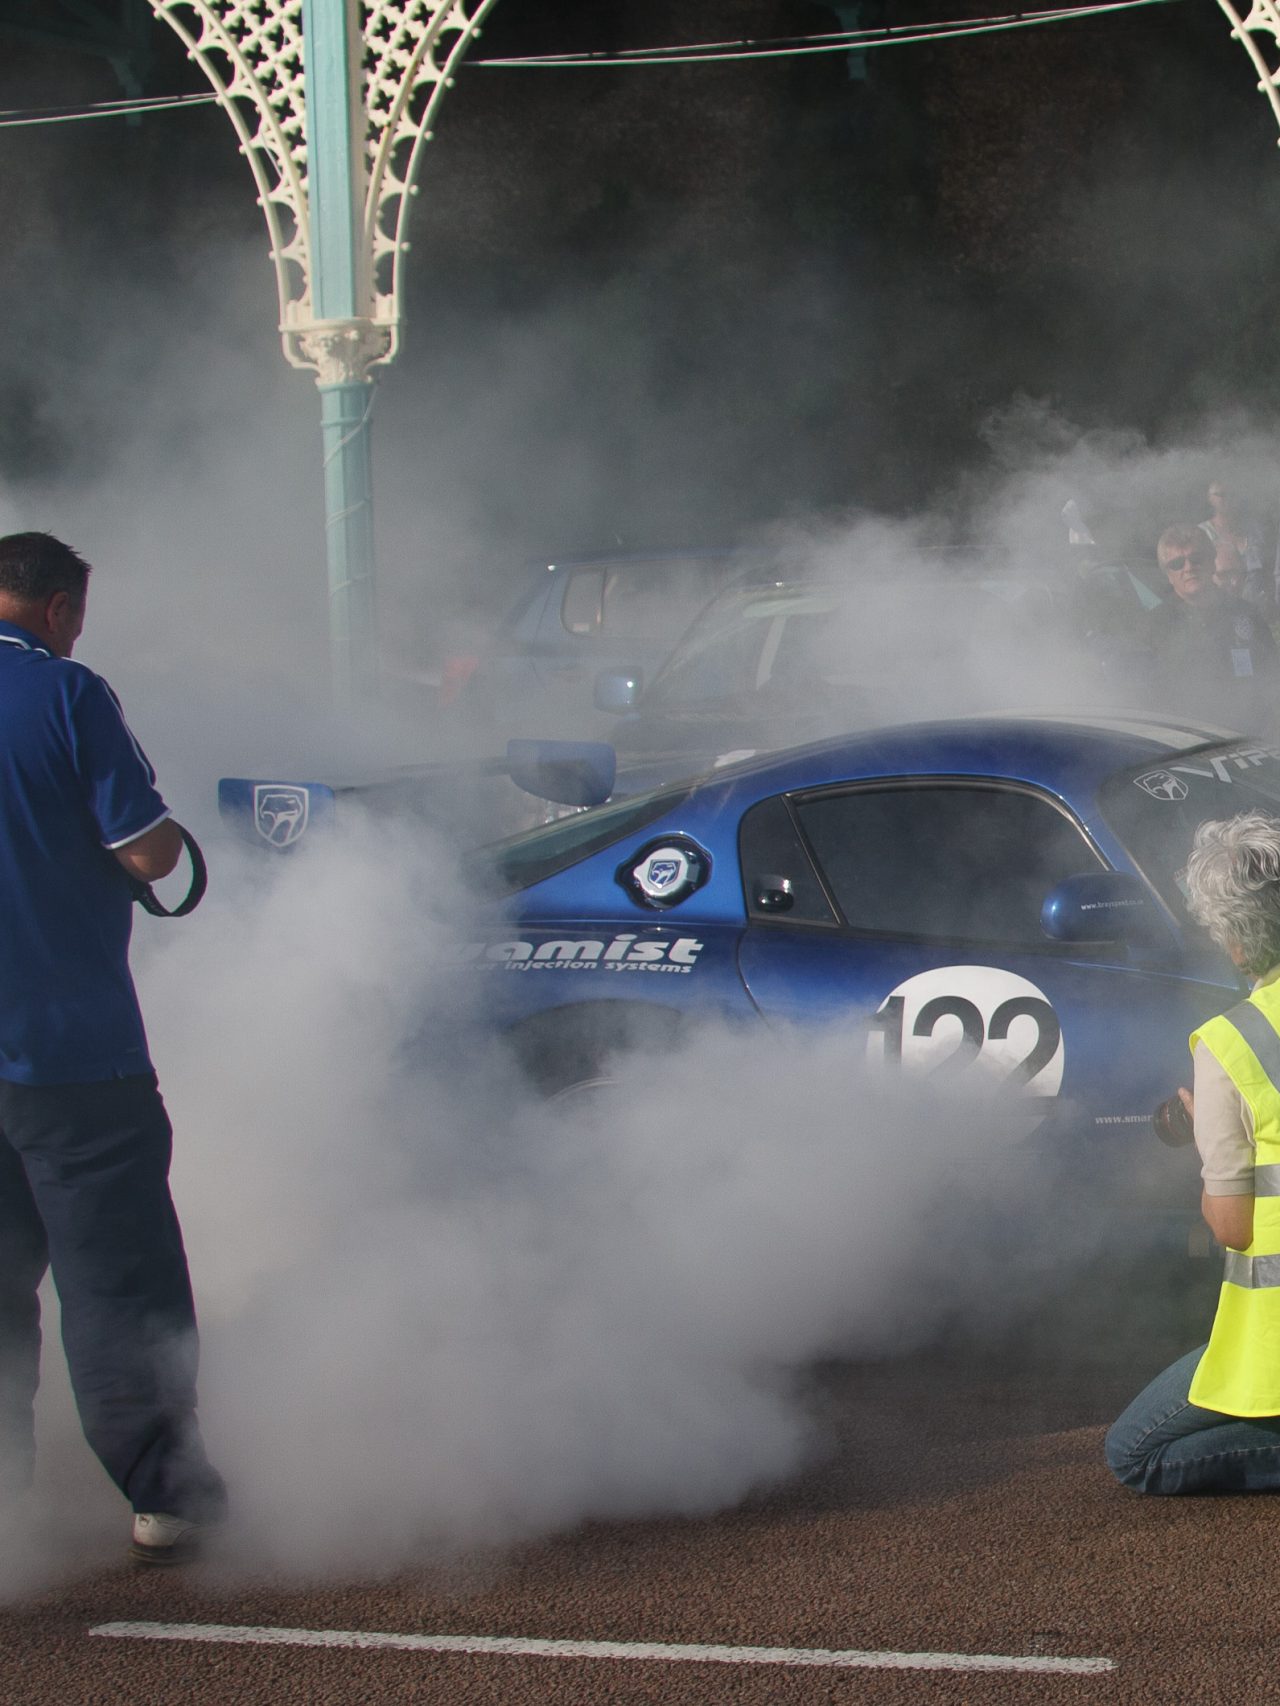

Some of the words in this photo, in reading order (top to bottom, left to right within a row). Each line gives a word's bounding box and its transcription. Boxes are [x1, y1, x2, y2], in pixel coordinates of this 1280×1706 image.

[504, 960, 597, 971] injection
[605, 961, 693, 974] systems
[864, 995, 1061, 1090] 122
